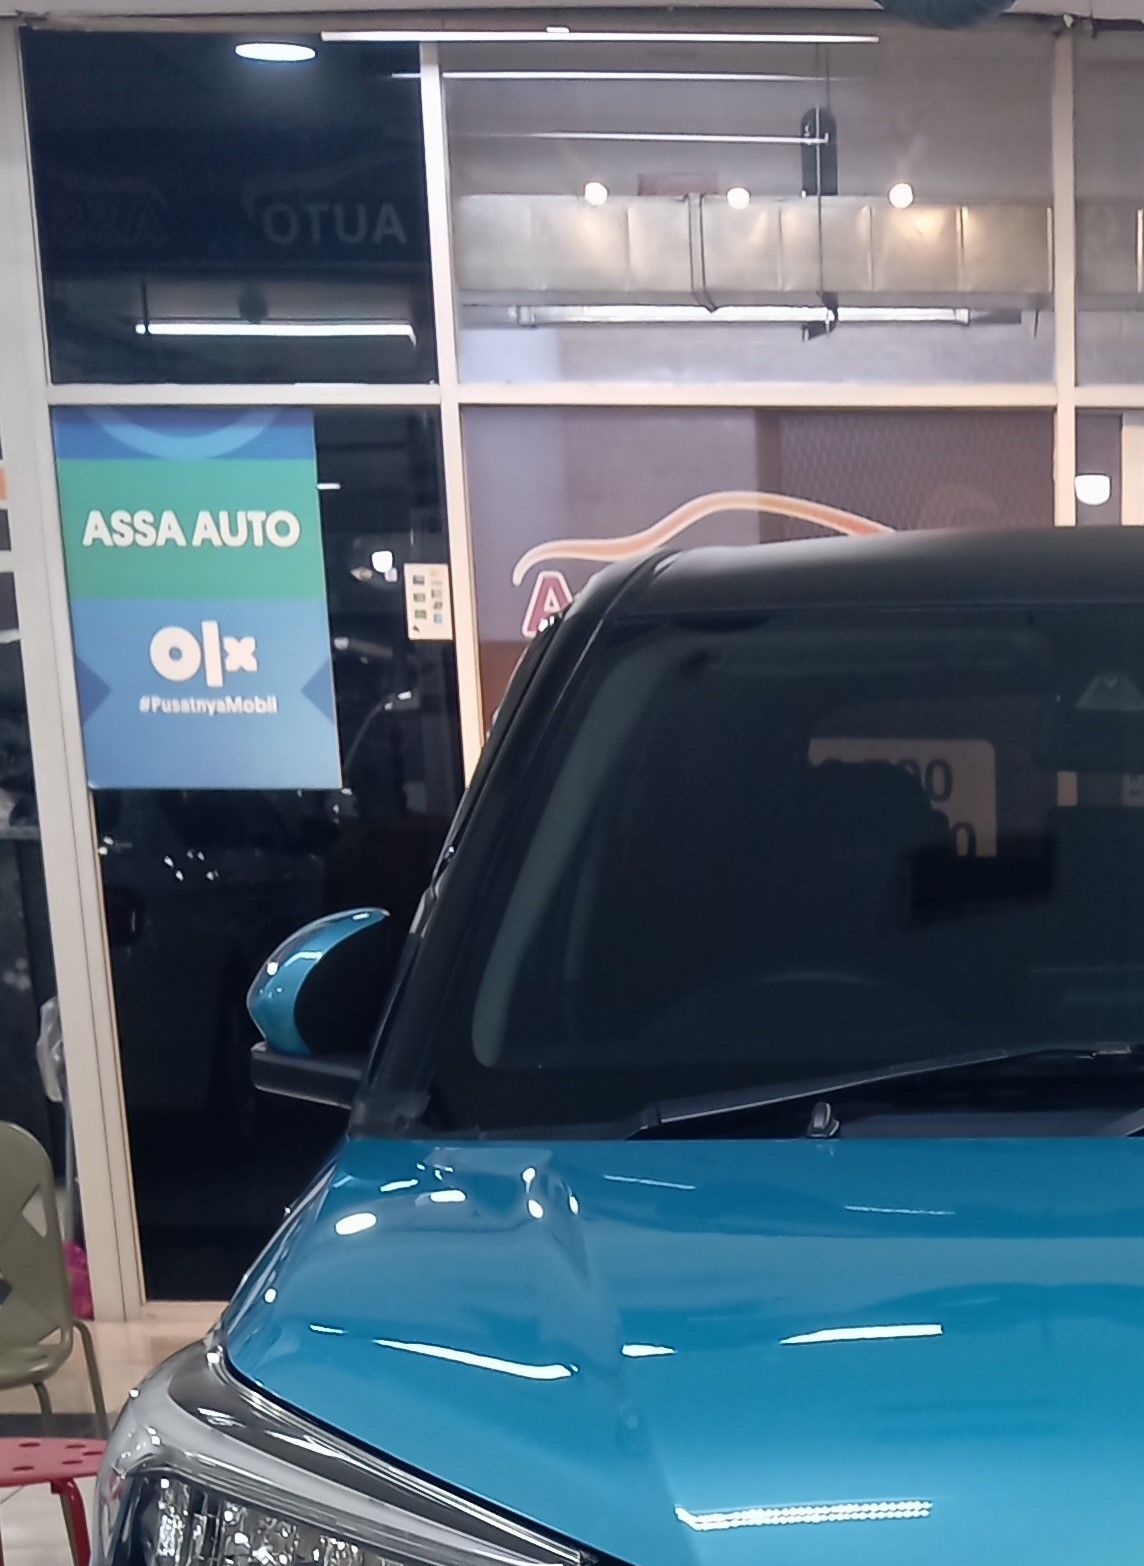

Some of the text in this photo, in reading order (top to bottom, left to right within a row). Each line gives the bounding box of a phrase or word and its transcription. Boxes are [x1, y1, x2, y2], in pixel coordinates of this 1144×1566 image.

[82, 510, 300, 547] ASSA AUTO
[150, 620, 258, 688] olx
[138, 696, 278, 716] #PusatnyaMobil
